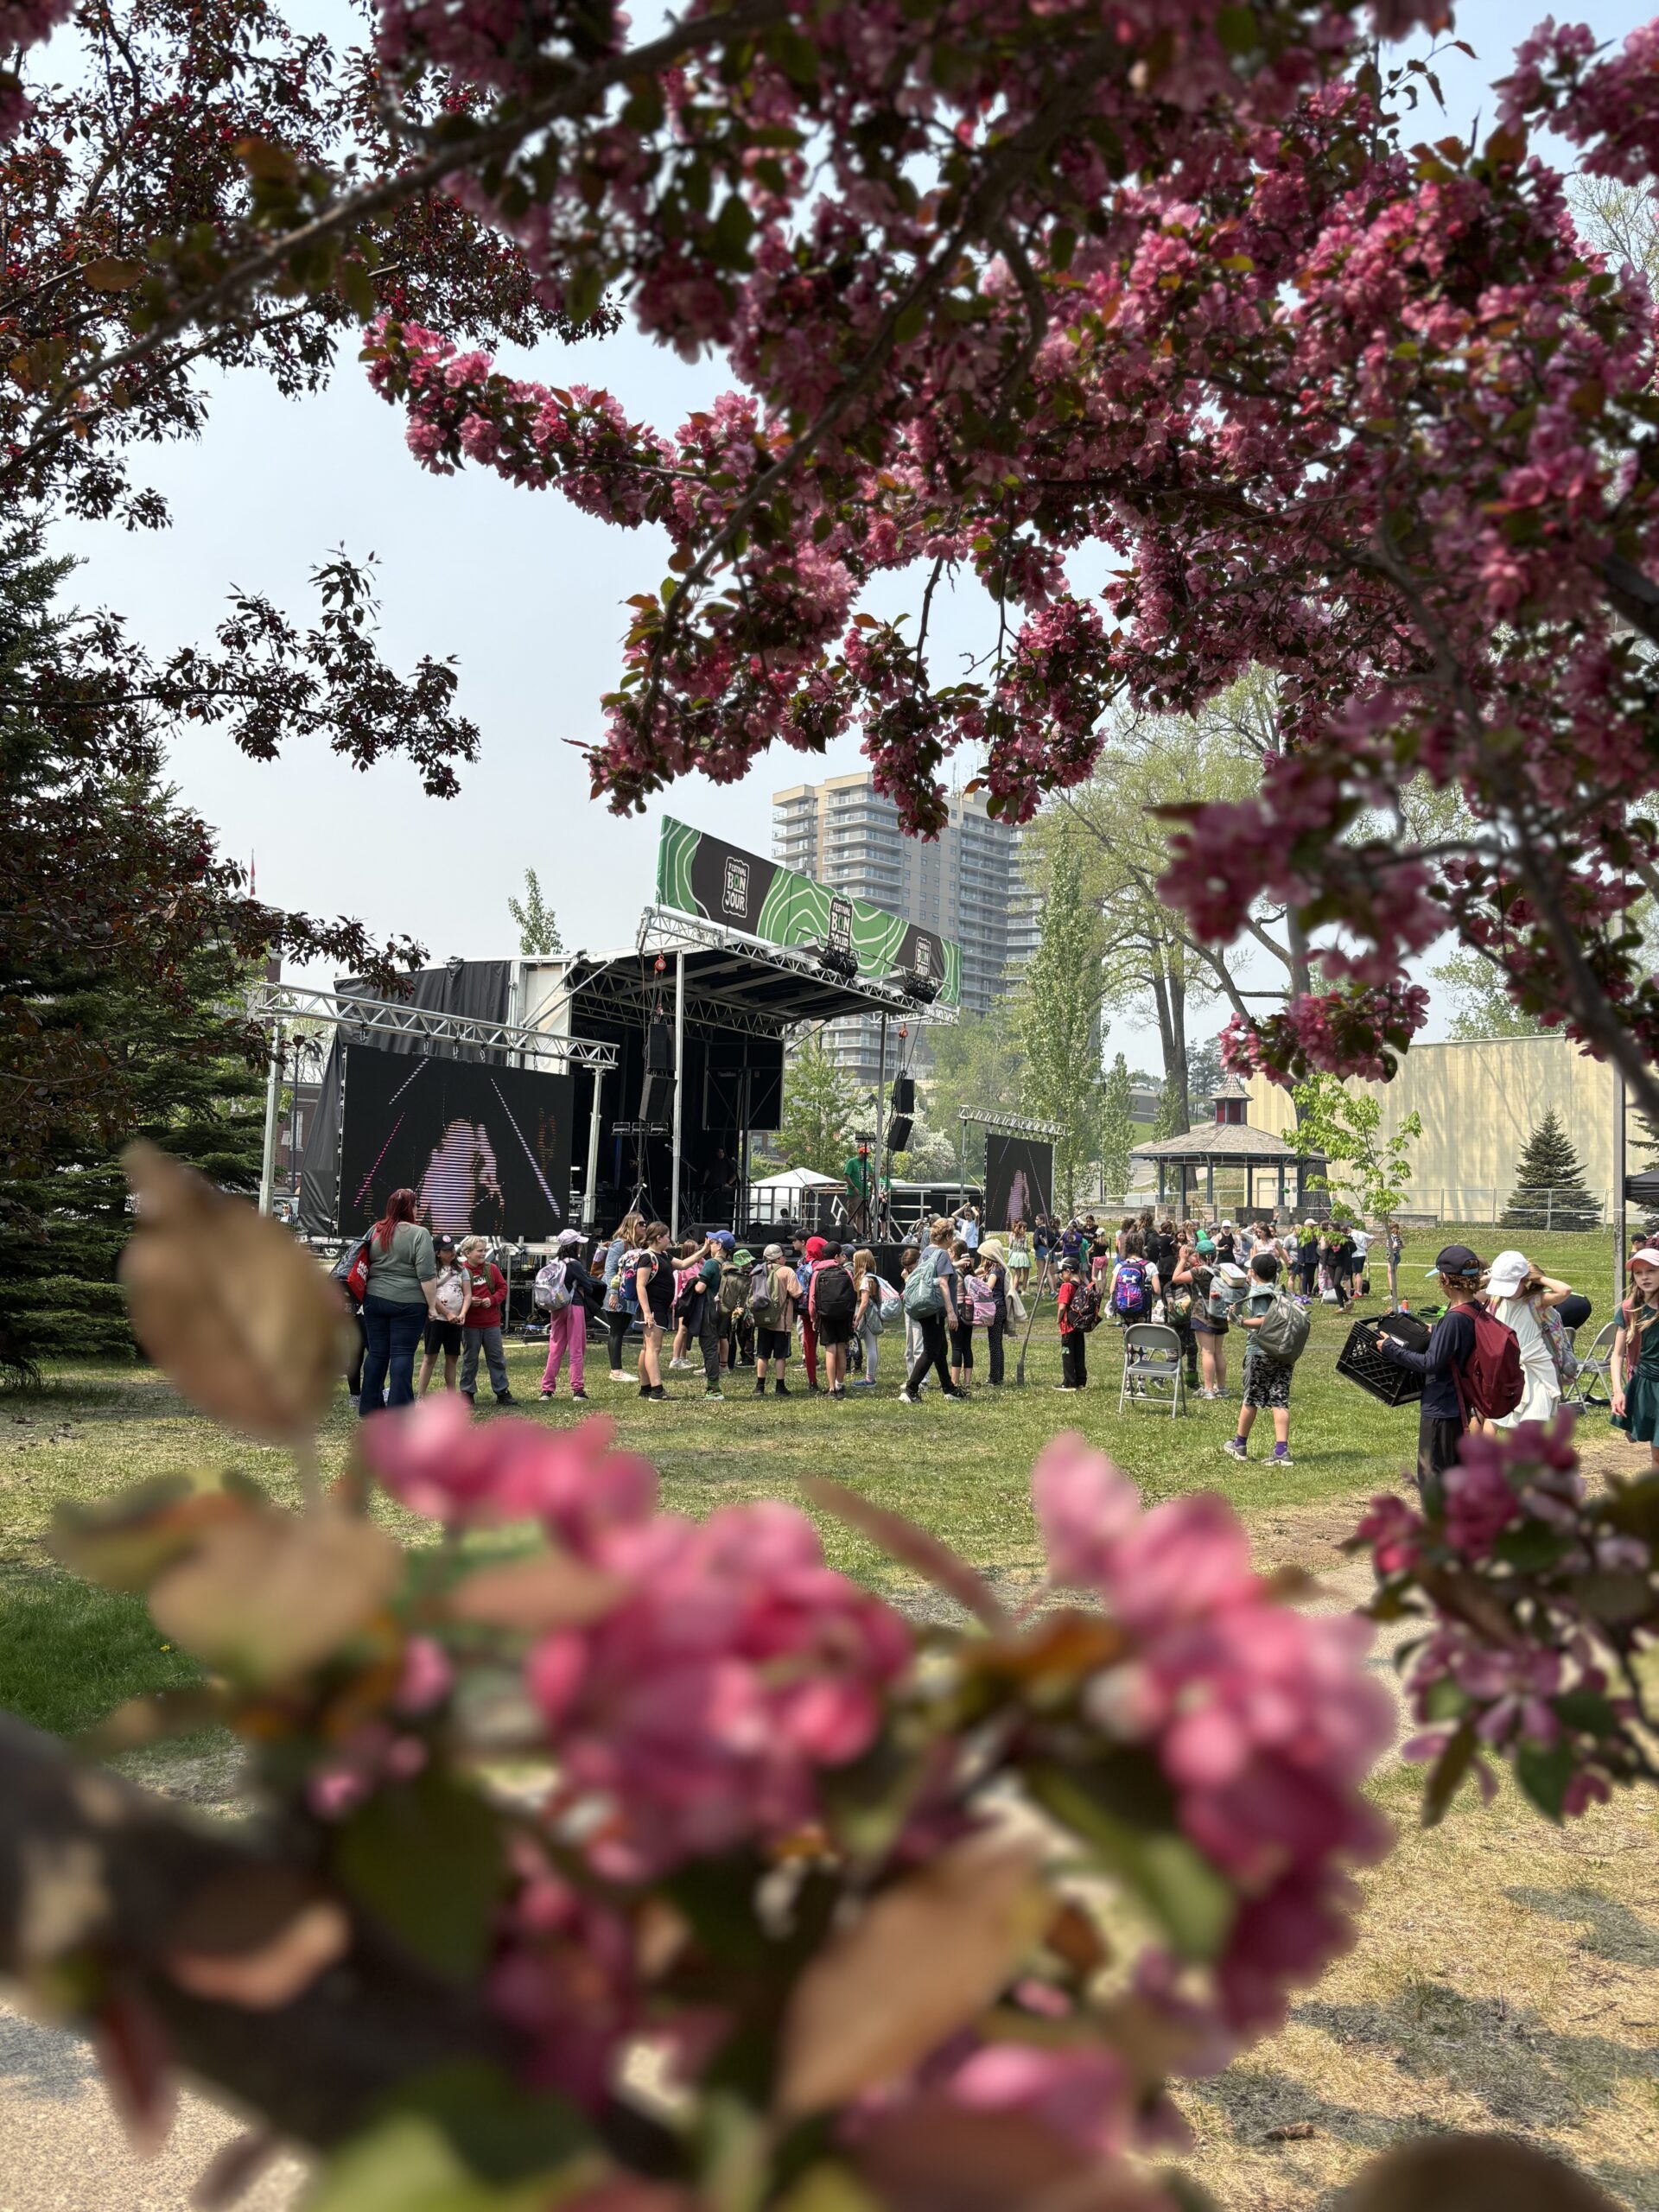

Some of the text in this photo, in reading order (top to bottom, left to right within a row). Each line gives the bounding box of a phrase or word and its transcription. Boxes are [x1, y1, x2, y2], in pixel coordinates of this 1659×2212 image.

[728, 863, 747, 877] FESTIVAL
[728, 872, 746, 891] BON
[725, 891, 745, 912] JOUR
[833, 902, 851, 917] FESTIVAL
[831, 912, 850, 932] BON
